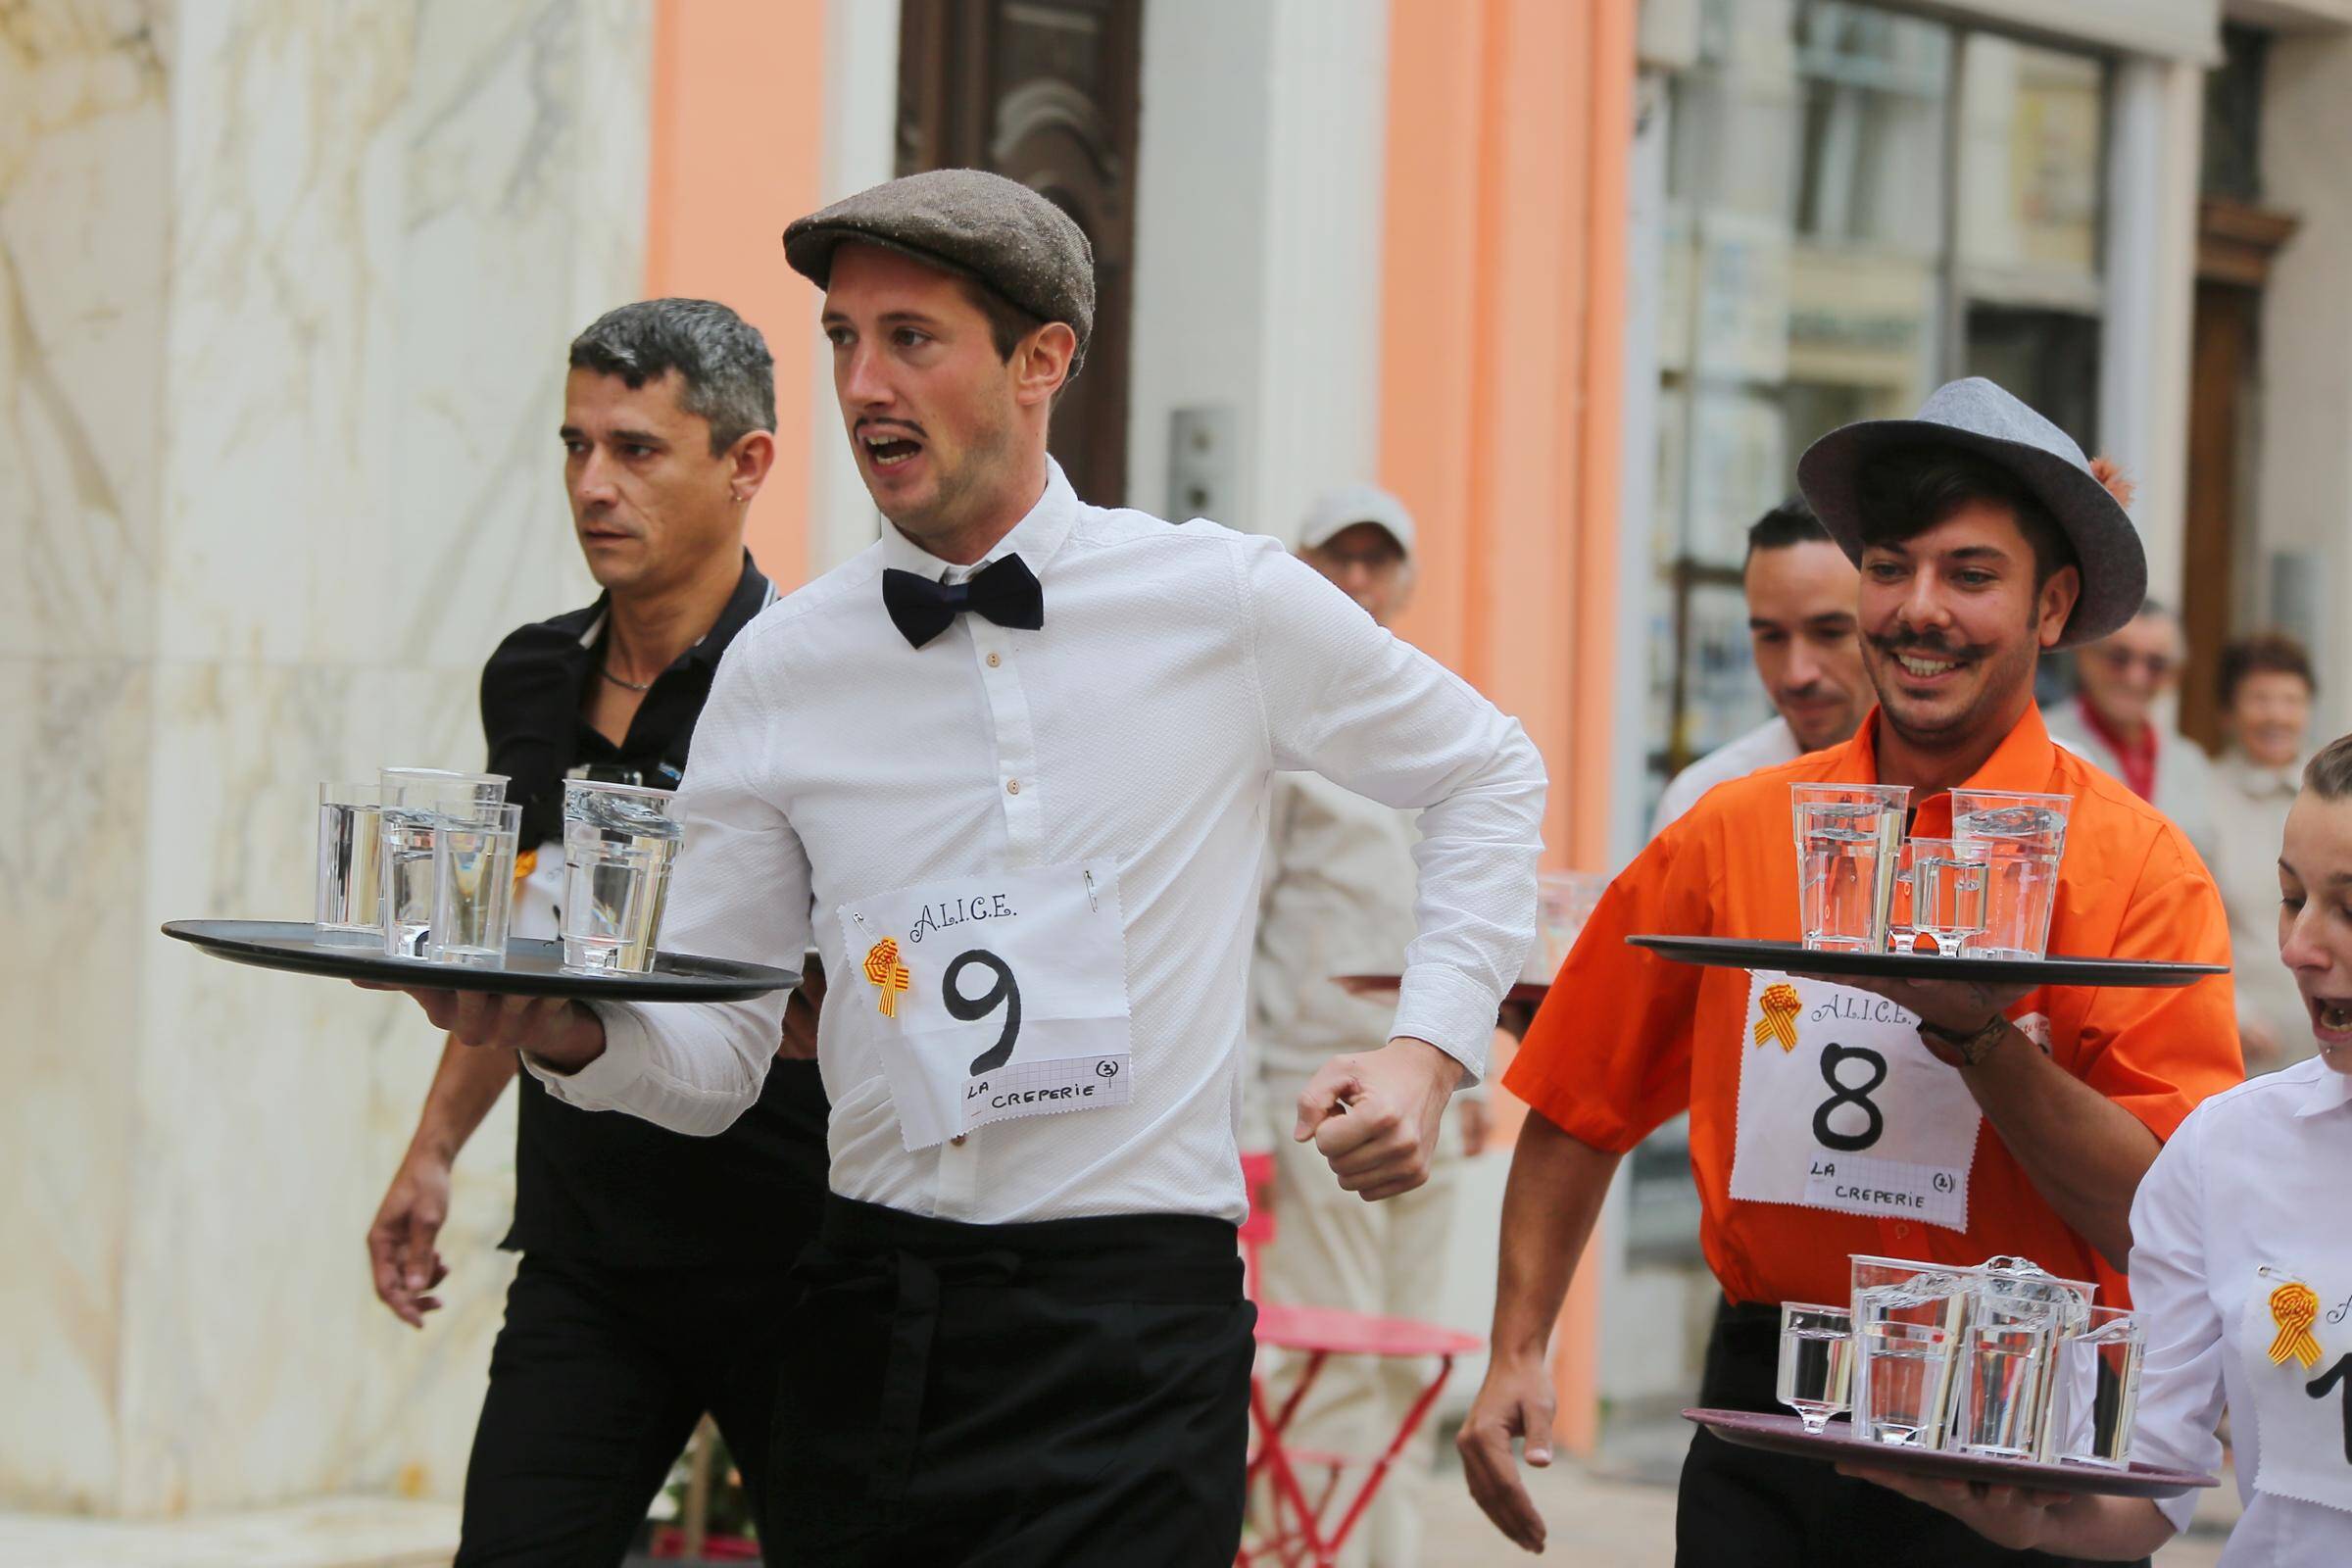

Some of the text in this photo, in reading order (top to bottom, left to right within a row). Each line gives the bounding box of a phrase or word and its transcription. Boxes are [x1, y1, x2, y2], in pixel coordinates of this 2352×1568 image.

[909, 893, 1018, 944] A.L.I.C.E.
[942, 948, 1022, 1077] 9
[966, 1081, 990, 1100] LA
[1812, 1042, 1887, 1152] 8
[1810, 1161, 1836, 1177] LA
